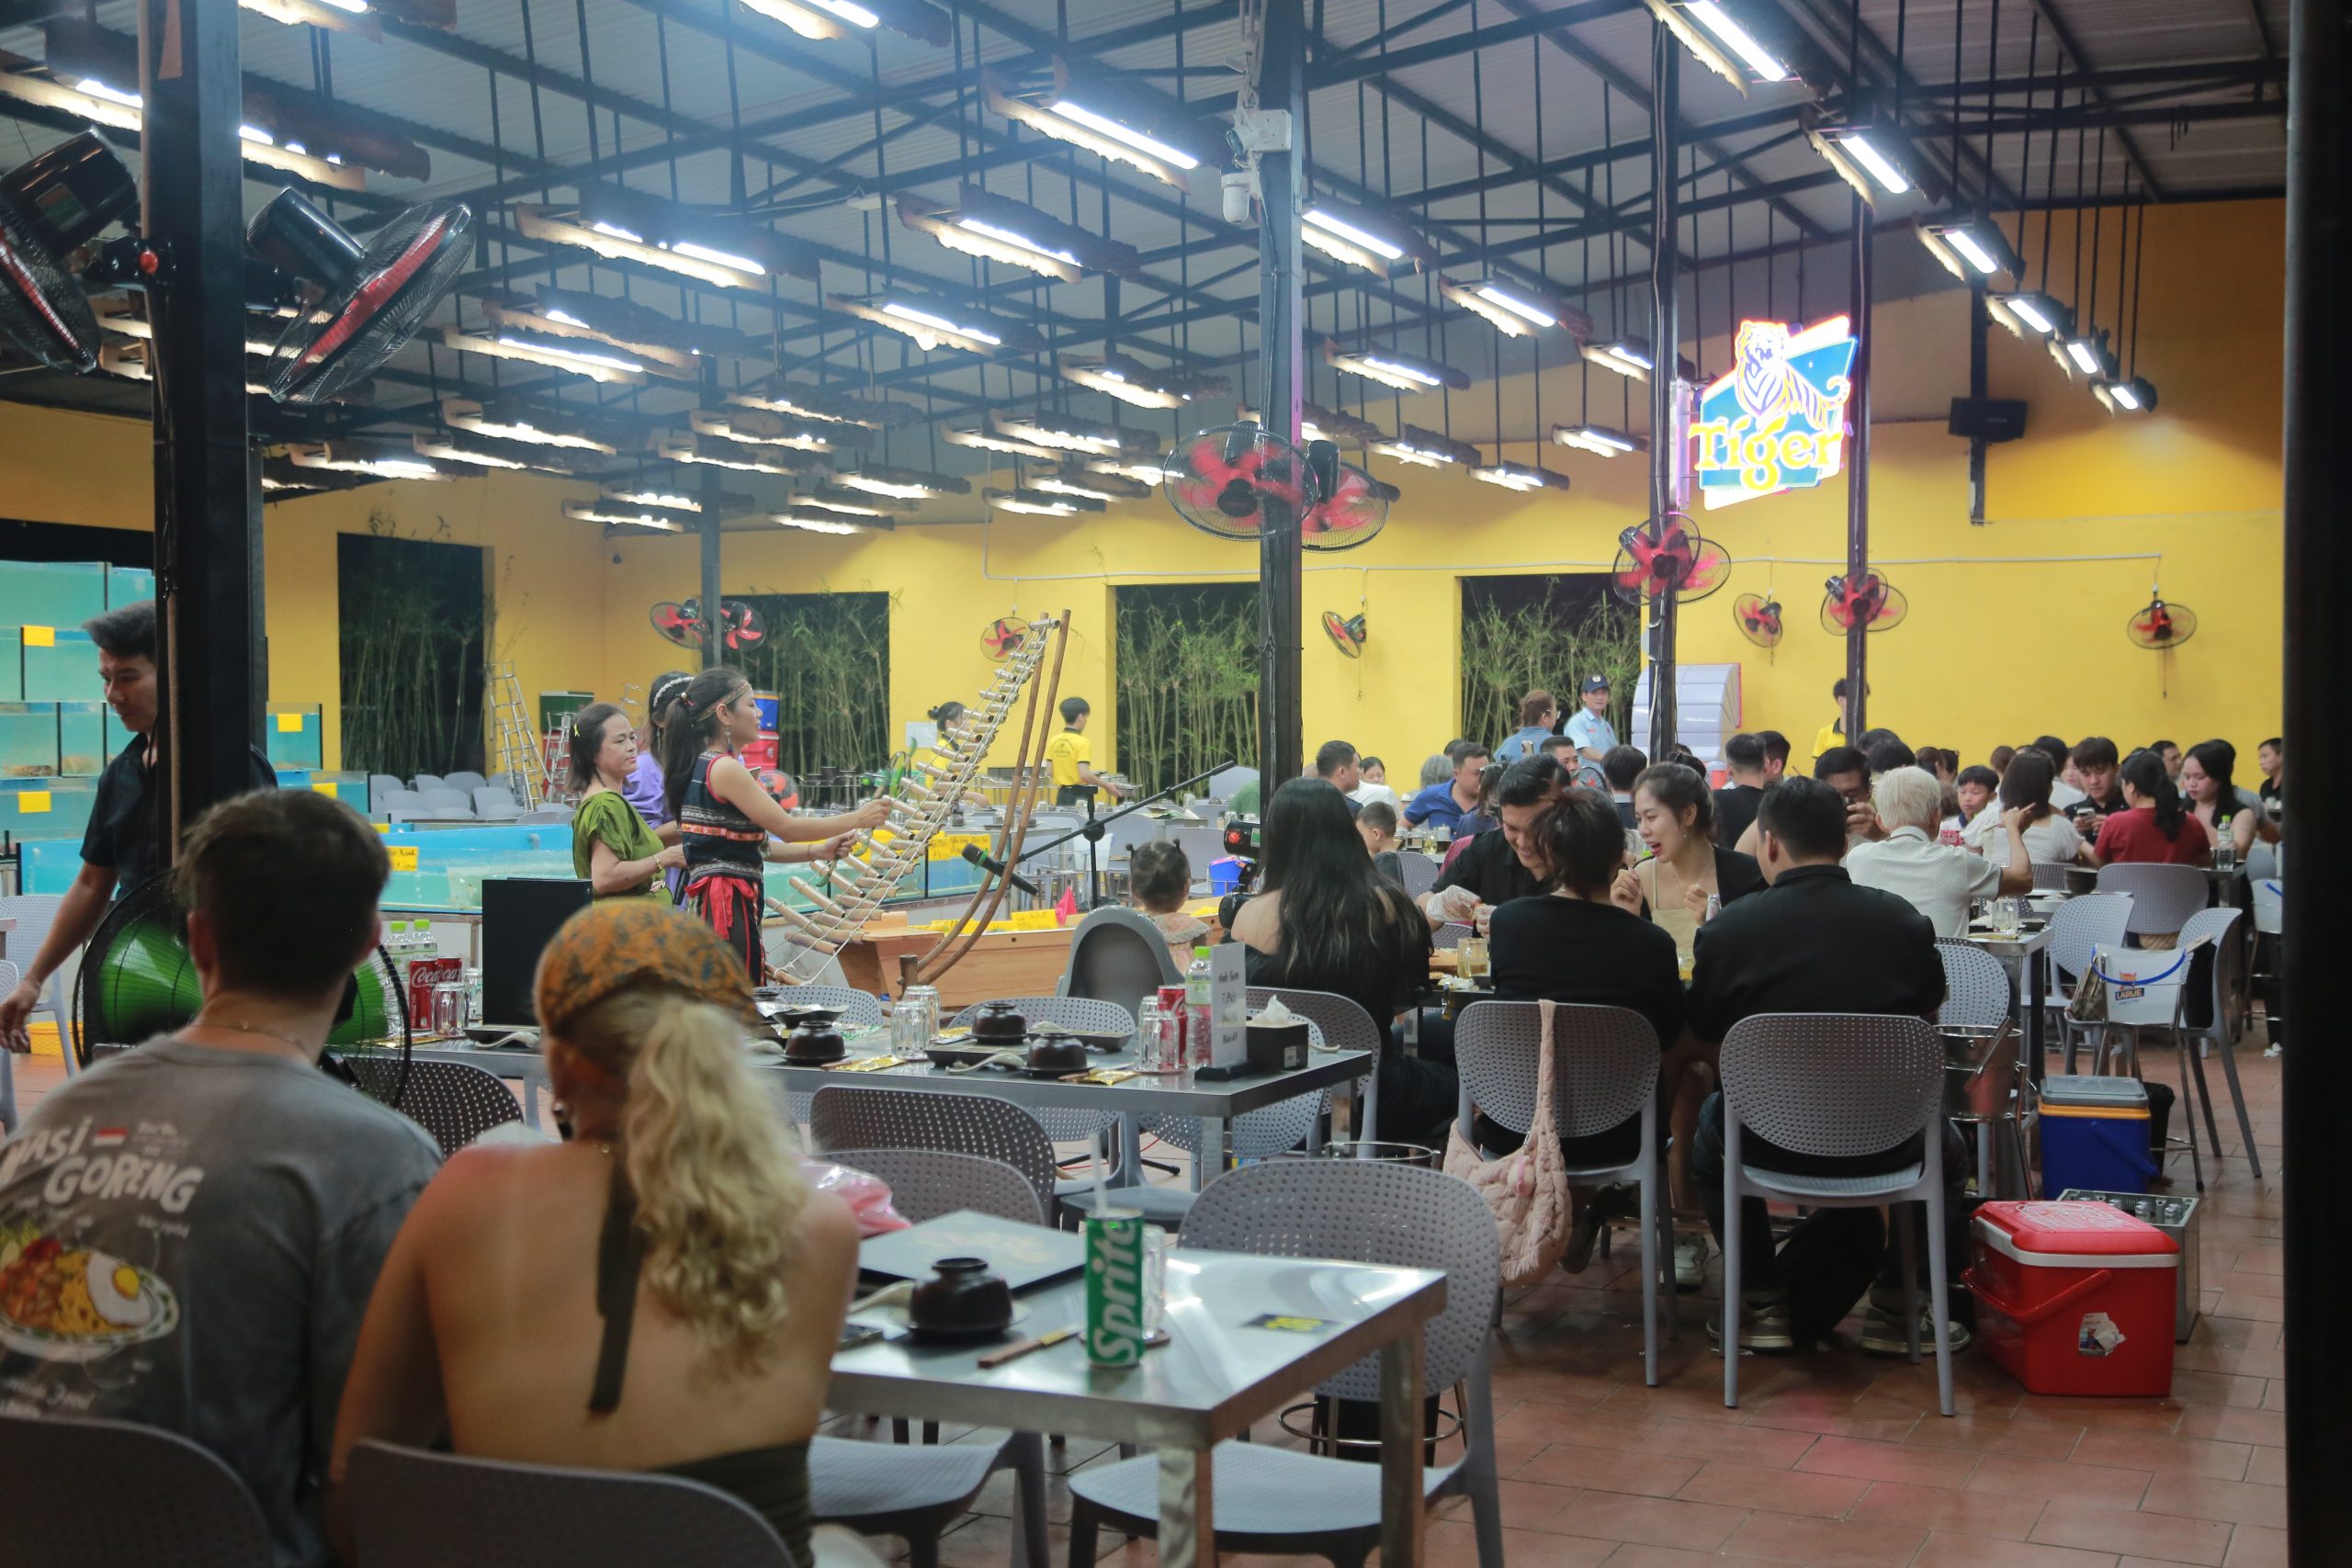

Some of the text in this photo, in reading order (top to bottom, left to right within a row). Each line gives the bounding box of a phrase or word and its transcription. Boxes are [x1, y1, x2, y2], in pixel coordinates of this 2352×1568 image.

[1688, 415, 1844, 491] Tiger
[44, 1152, 204, 1213] GORENG
[1091, 1221, 1143, 1363] Sprite
